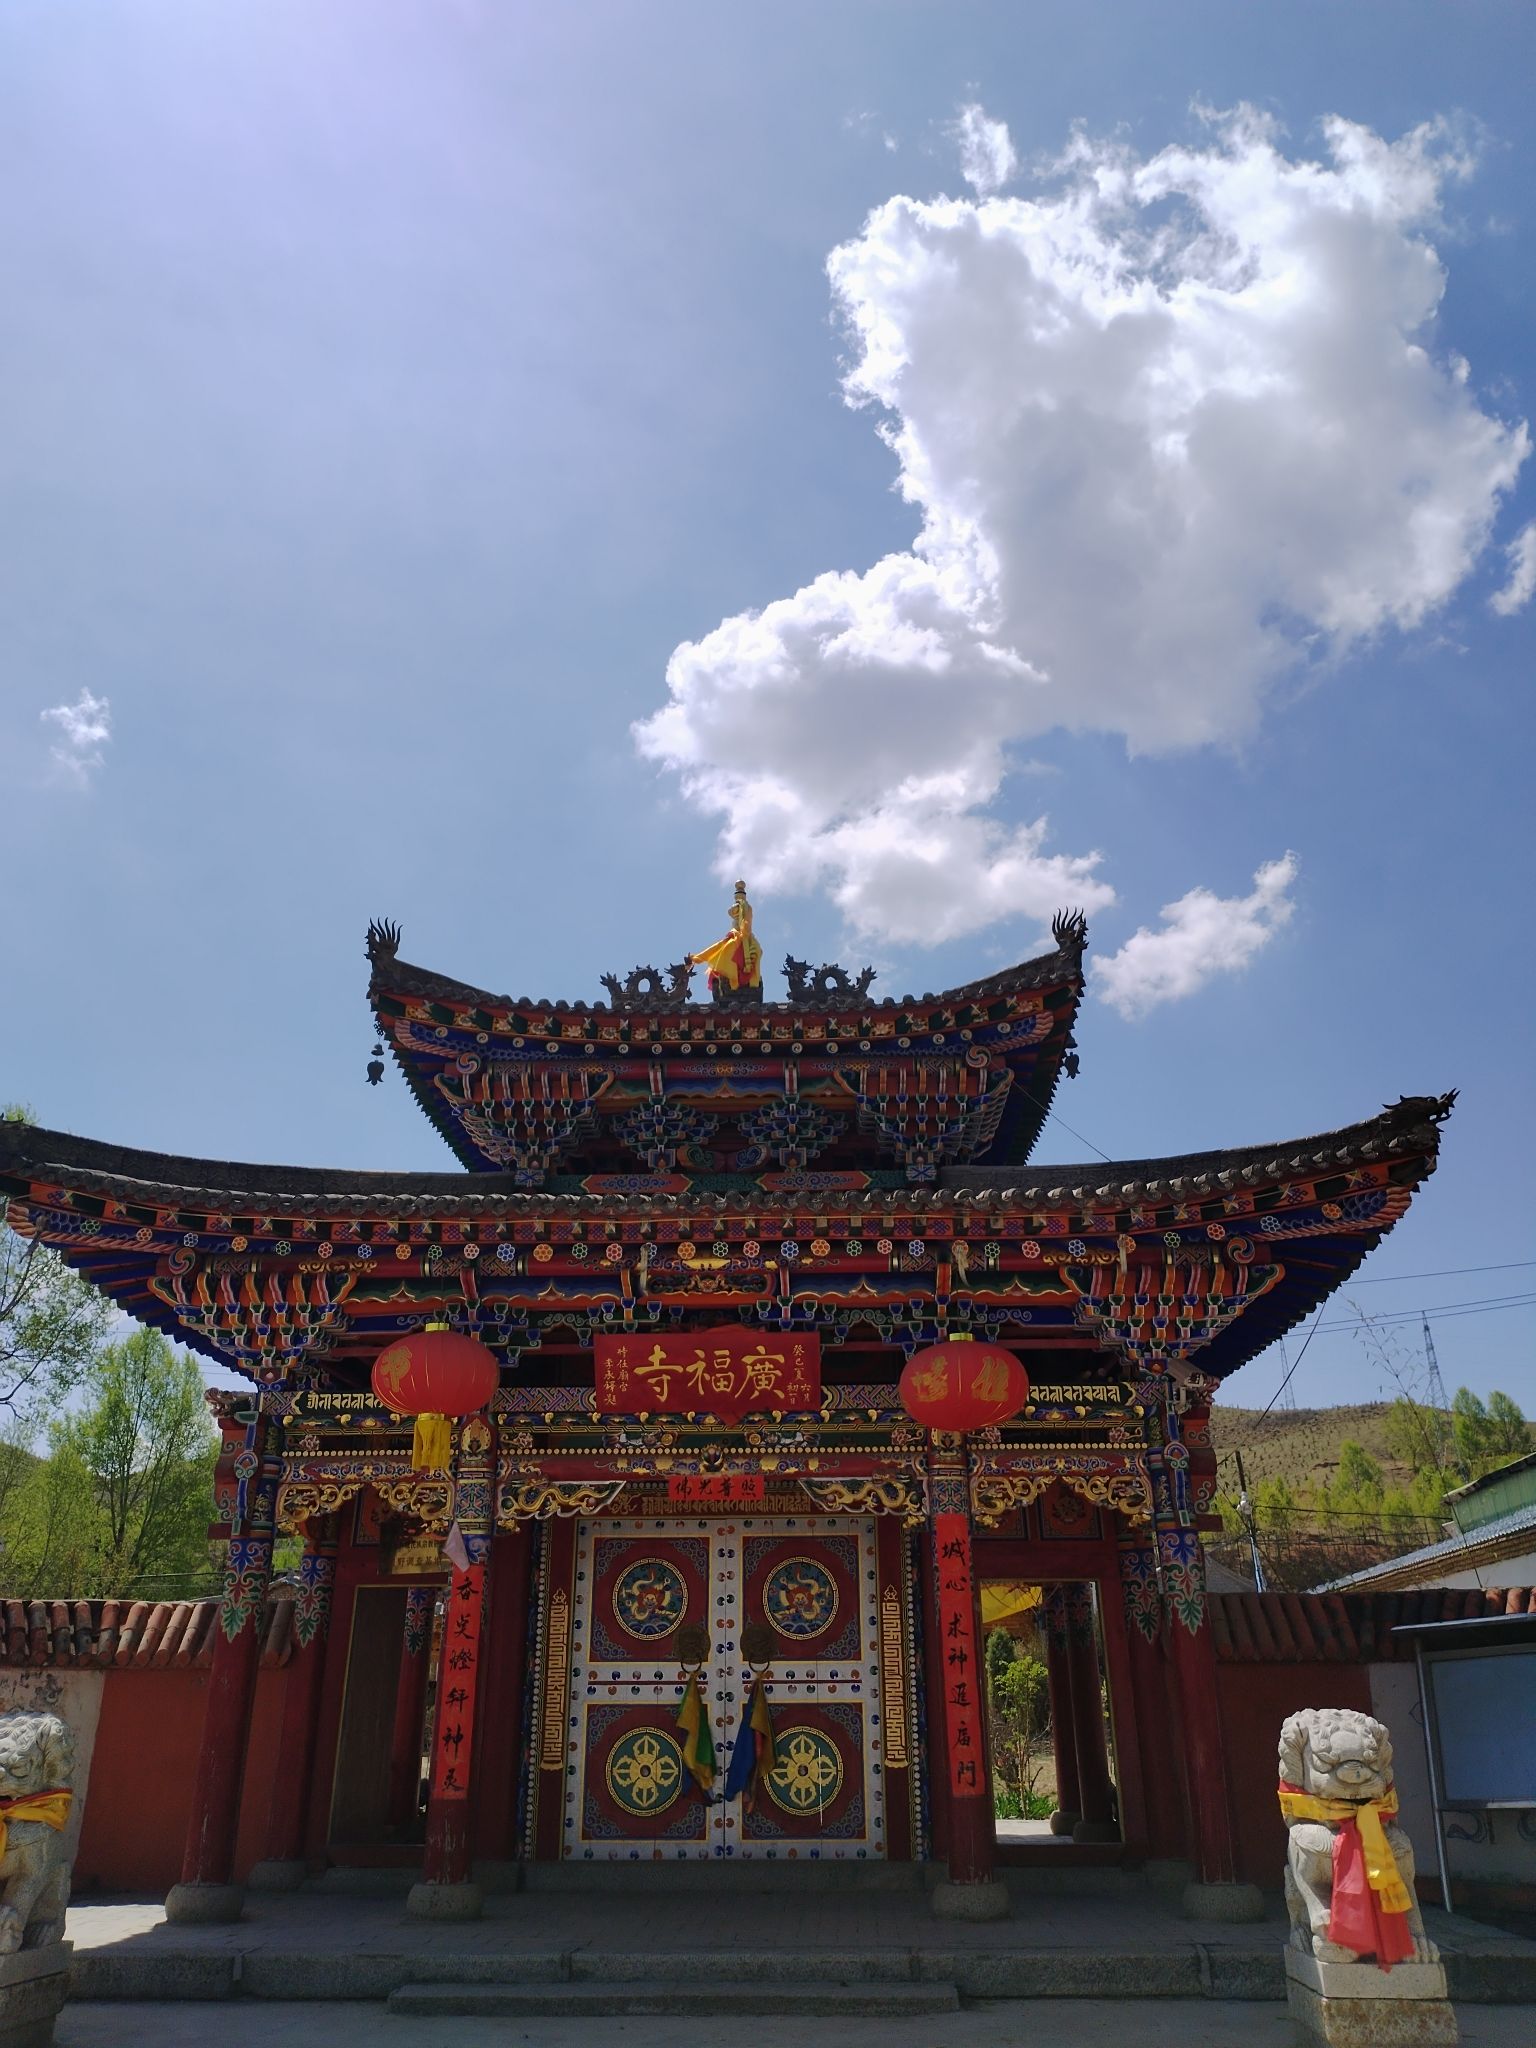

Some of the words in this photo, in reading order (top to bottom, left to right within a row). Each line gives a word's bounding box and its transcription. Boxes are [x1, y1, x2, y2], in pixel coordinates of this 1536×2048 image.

[633, 1344, 785, 1402] 廣福寺
[675, 1477, 757, 1498] 佛光普照
